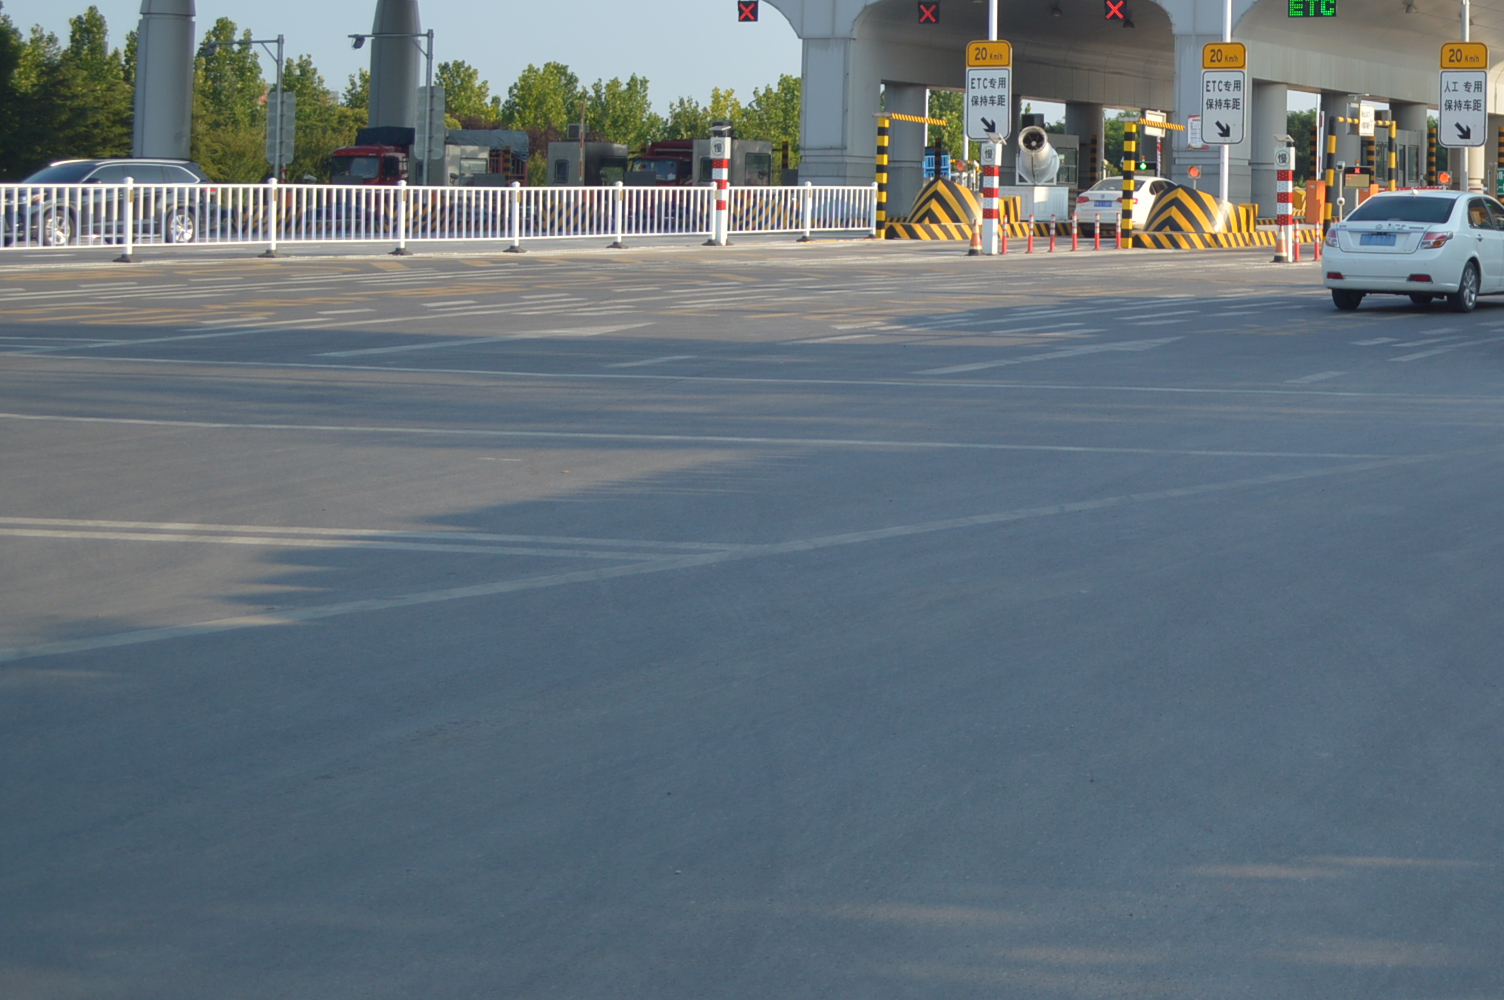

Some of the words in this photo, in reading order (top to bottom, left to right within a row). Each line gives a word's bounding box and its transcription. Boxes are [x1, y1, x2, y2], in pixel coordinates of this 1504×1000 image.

[974, 47, 988, 61] 20
[1209, 48, 1223, 63] 20
[1448, 48, 1463, 63] 20
[970, 94, 1006, 107] 保持车距
[1205, 98, 1241, 110] 保持车距
[1443, 98, 1482, 112] 保持车距
[983, 147, 995, 160] 慢
[1277, 152, 1289, 166] 慢
